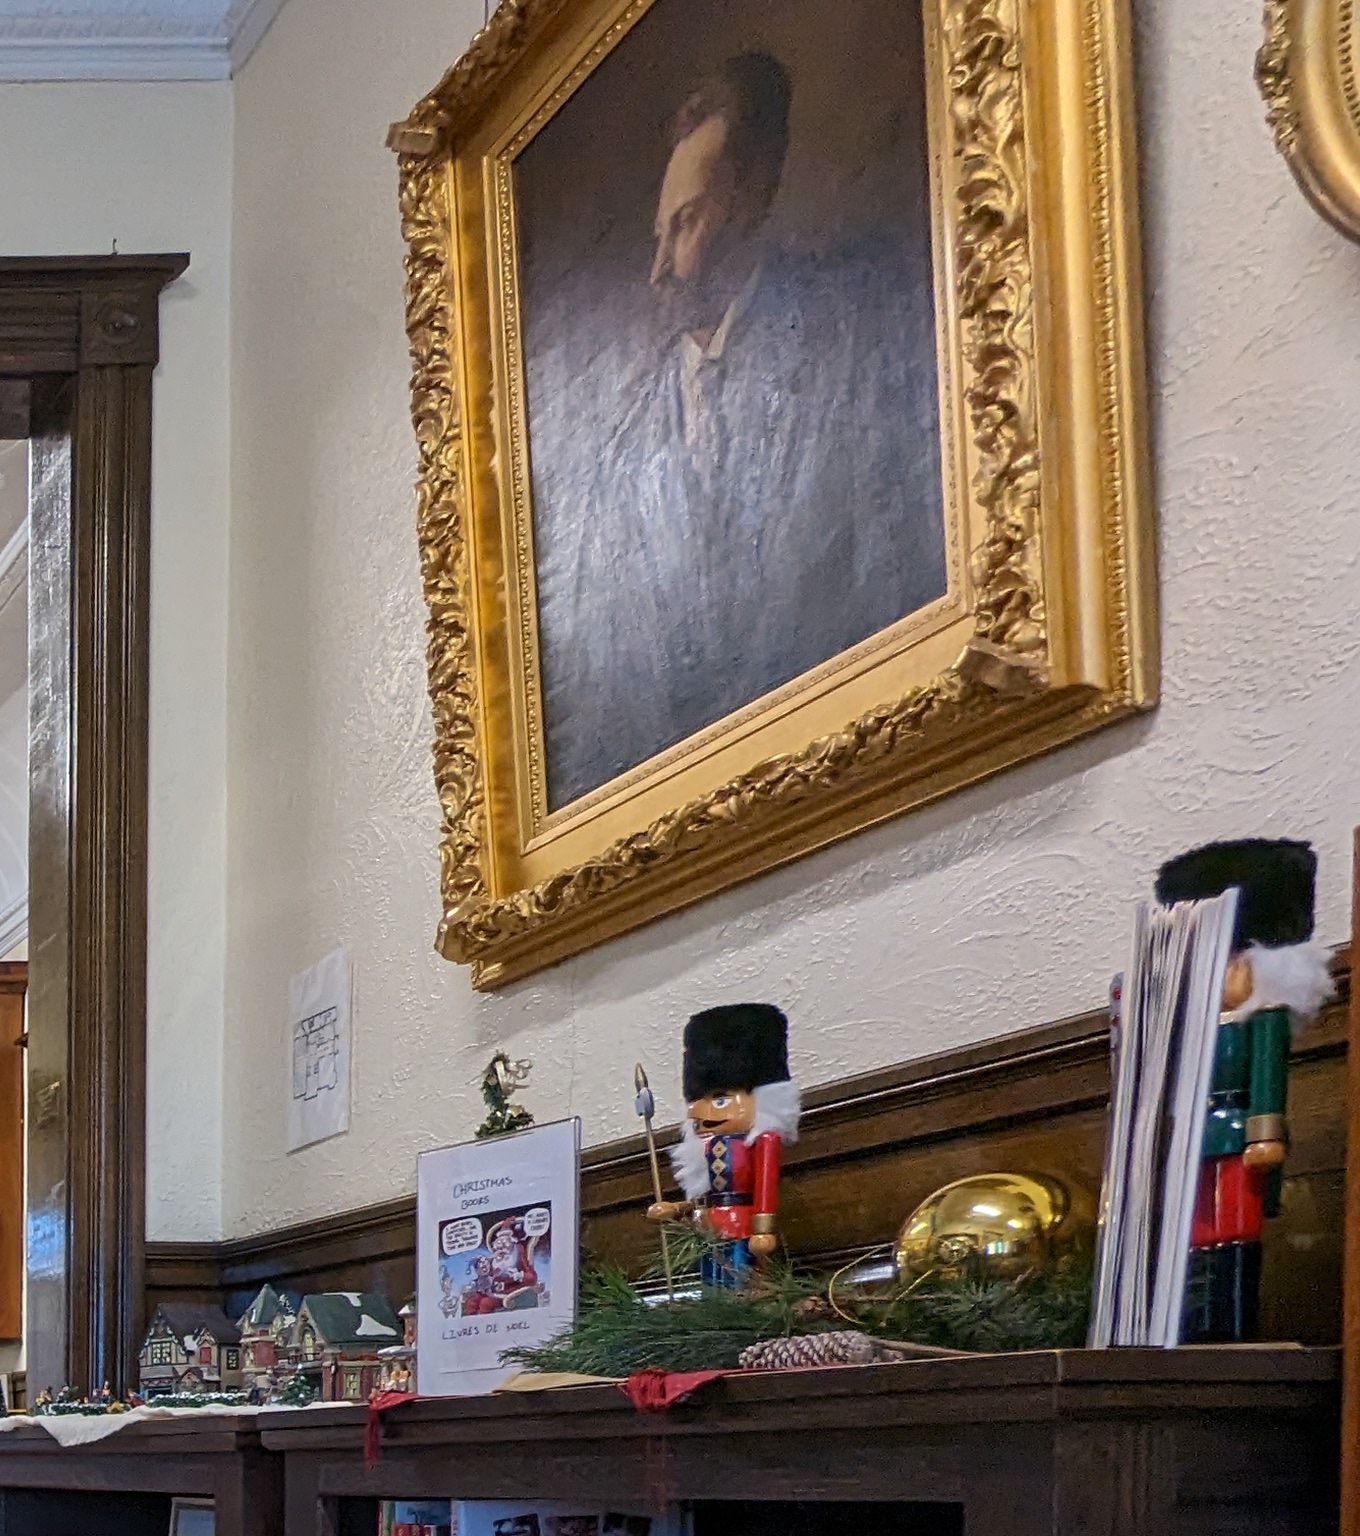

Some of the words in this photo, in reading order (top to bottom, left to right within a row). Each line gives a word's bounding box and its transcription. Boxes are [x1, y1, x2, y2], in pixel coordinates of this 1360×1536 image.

[453, 1176, 513, 1199] CHRISTMAS
[461, 1195, 490, 1210] BOOKS
[441, 1326, 480, 1341] LIVRES
